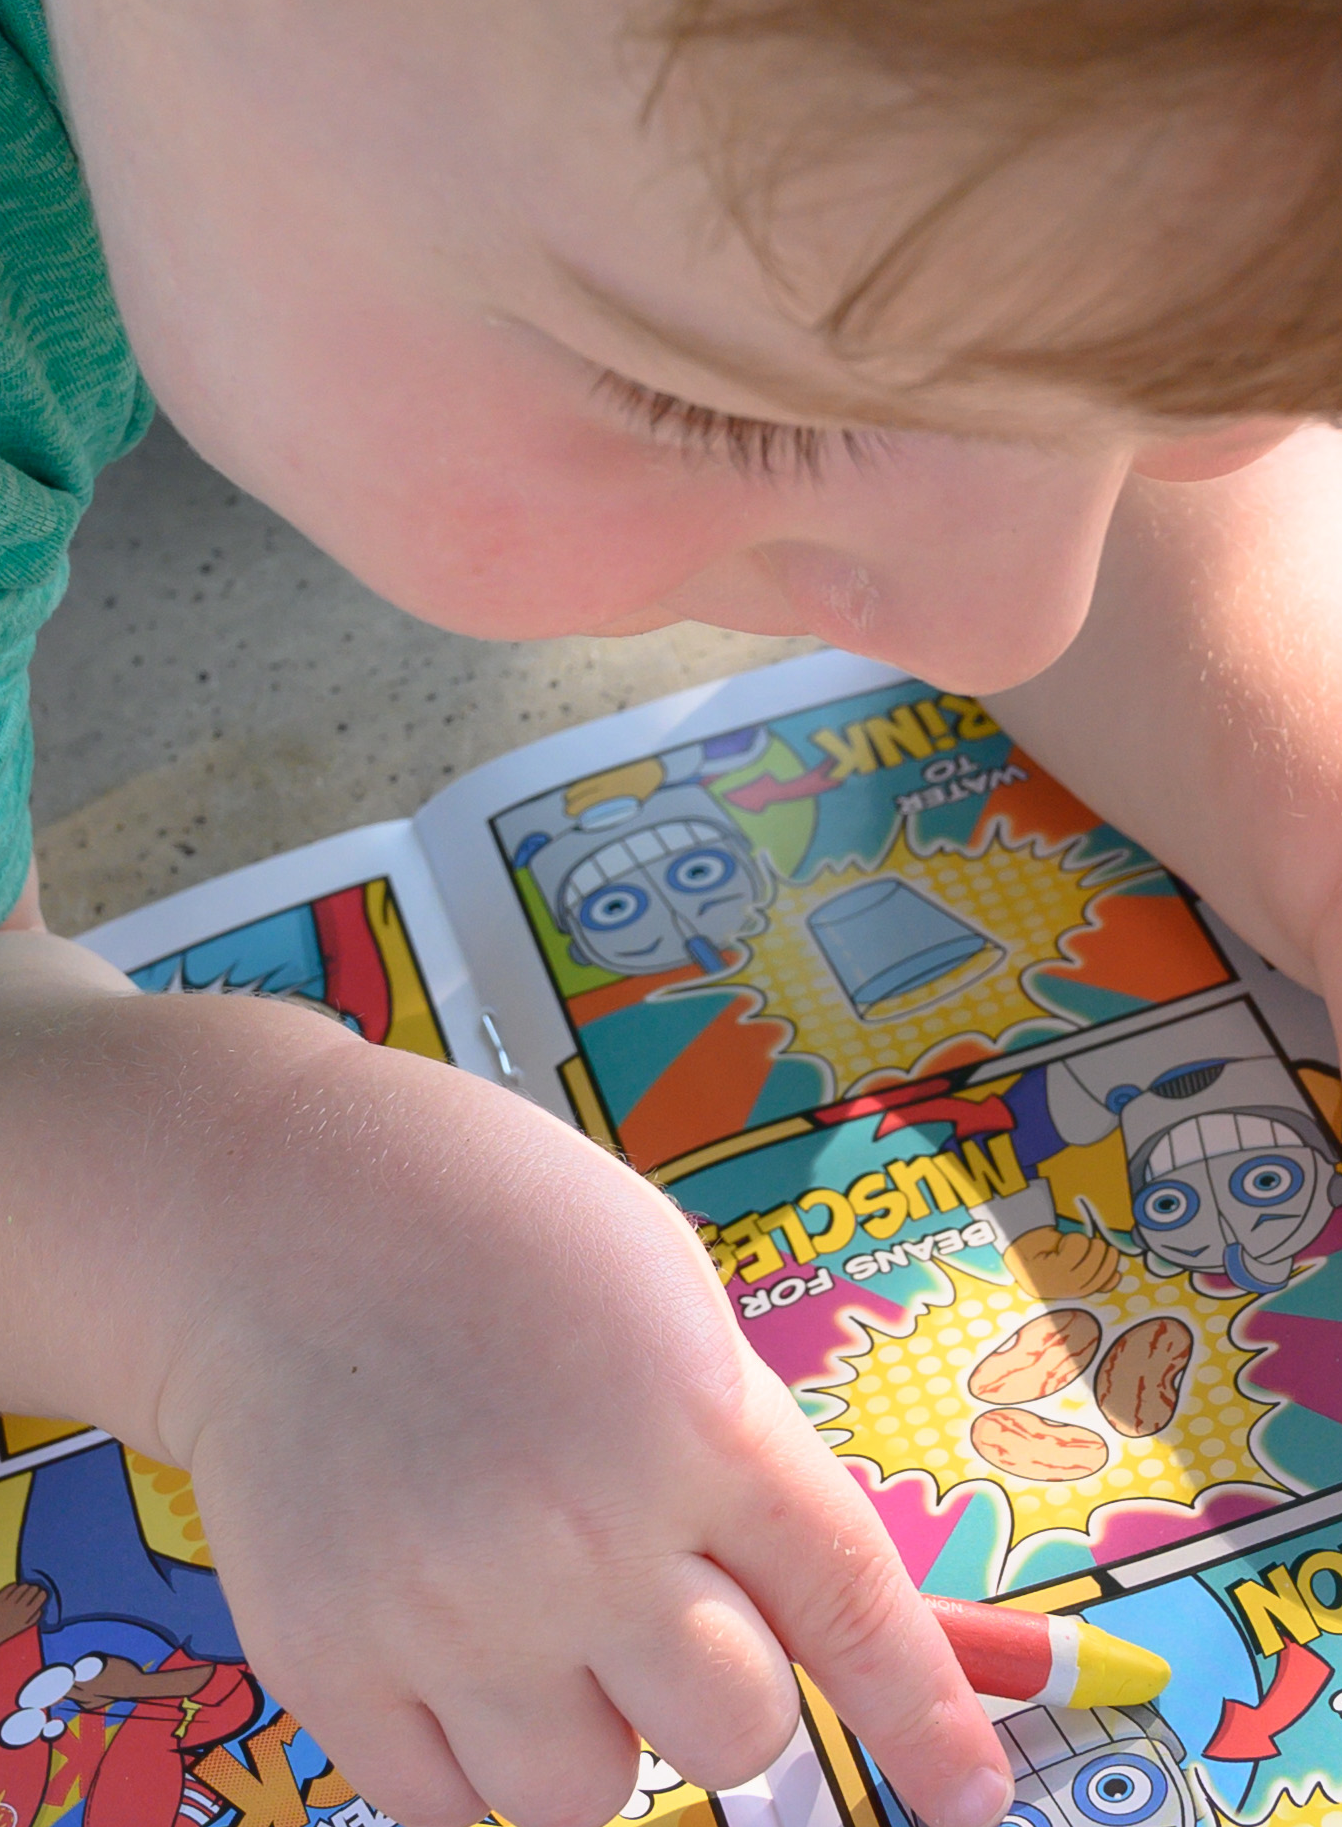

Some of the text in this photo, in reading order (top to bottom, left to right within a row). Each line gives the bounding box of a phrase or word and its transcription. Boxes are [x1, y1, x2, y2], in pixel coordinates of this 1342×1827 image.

[894, 764, 1027, 815] WATER
[923, 754, 979, 782] TO
[739, 1220, 996, 1319] BEANS FOR
